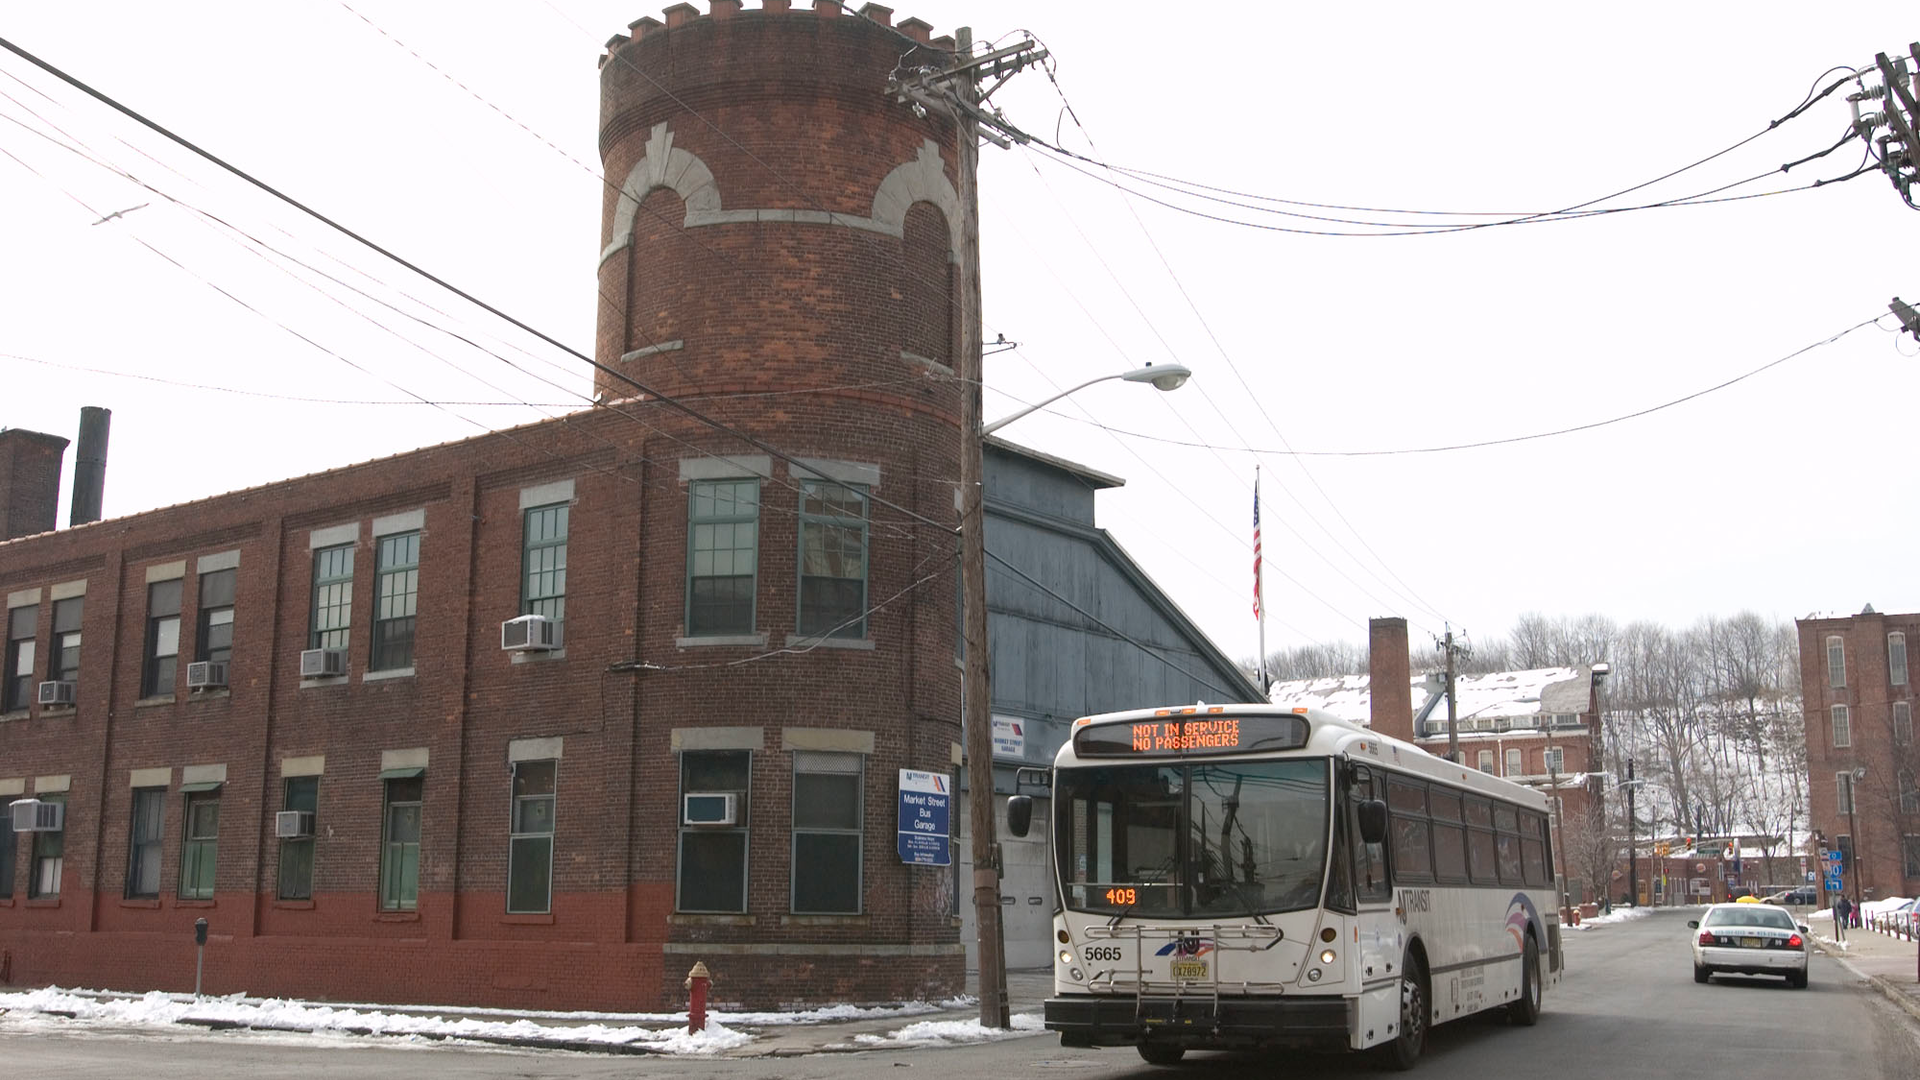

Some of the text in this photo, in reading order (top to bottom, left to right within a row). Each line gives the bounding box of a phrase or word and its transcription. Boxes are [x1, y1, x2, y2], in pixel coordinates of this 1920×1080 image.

[1132, 720, 1240, 738] NOT IN SERVICE
[1132, 734, 1239, 751] NO PASSENGERS
[903, 794, 946, 807] Market Street
[920, 808, 931, 818] Bus
[914, 819, 936, 831] Garage
[1106, 888, 1136, 905] 409
[1405, 889, 1431, 913] TRANSIT
[1084, 947, 1122, 961] 5665
